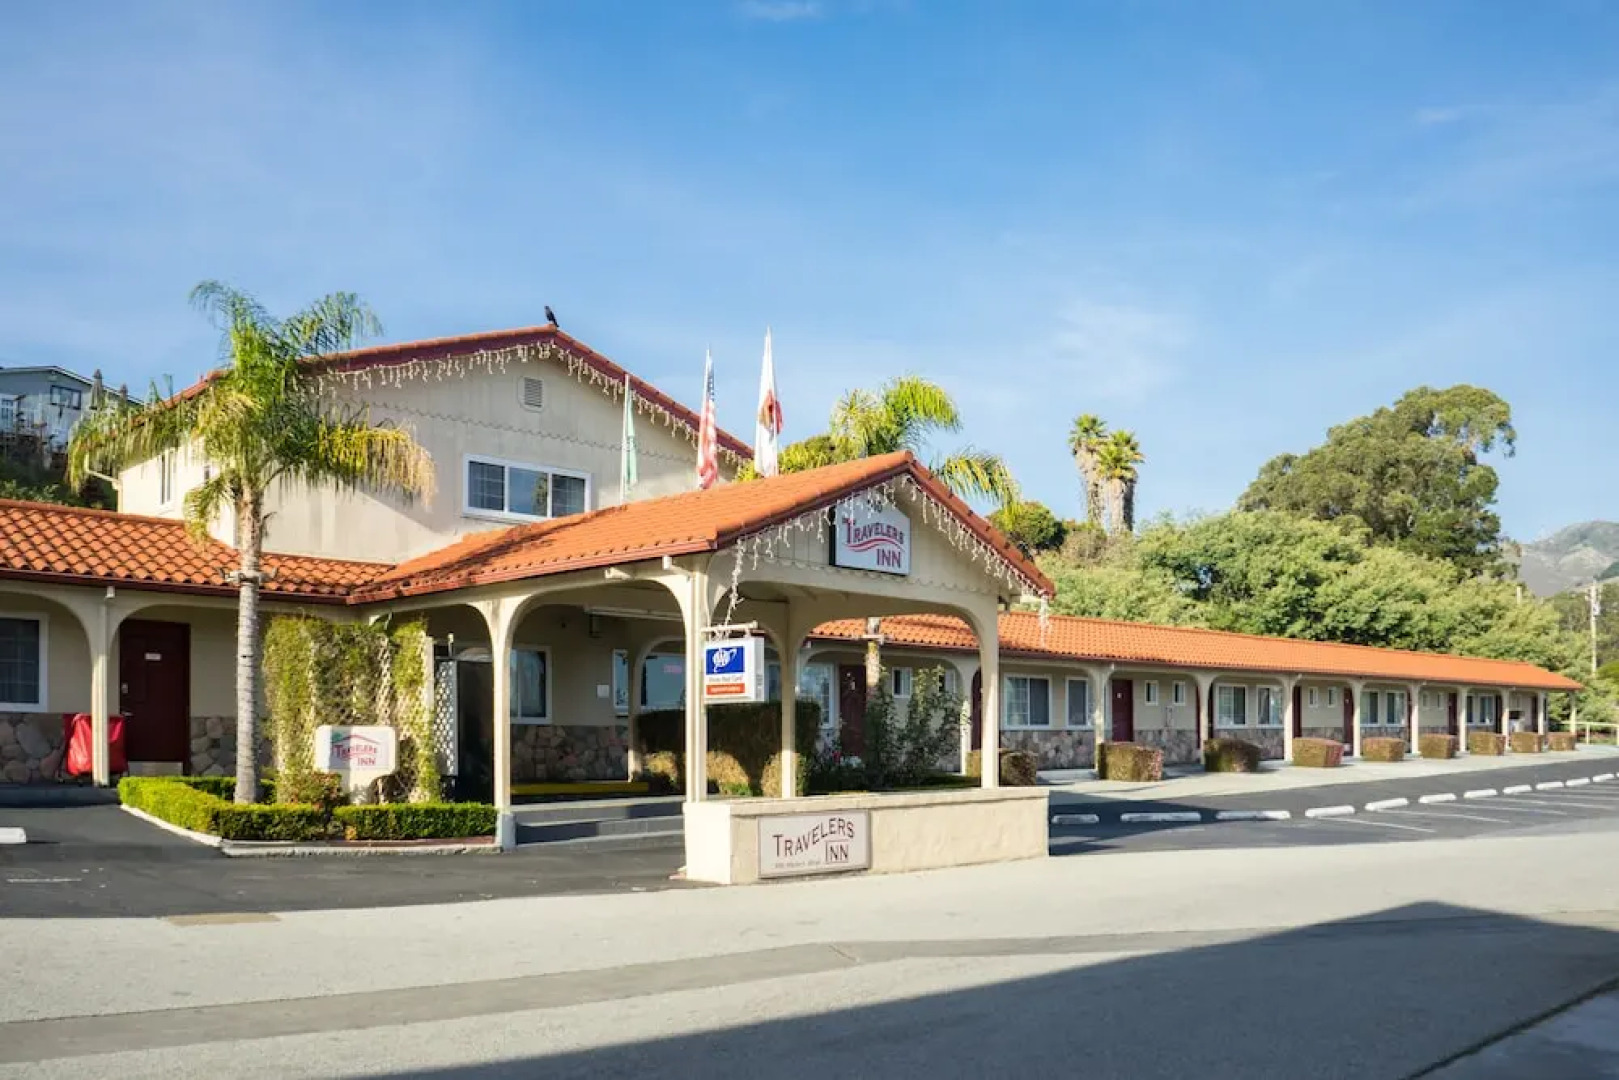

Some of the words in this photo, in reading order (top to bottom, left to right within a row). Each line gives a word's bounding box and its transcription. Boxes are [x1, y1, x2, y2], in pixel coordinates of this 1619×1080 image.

[842, 518, 904, 544] TRAVELERS
[877, 549, 901, 568] INN
[357, 757, 377, 766] INN
[772, 817, 855, 857] TRAVELERS
[825, 841, 849, 862] INN
